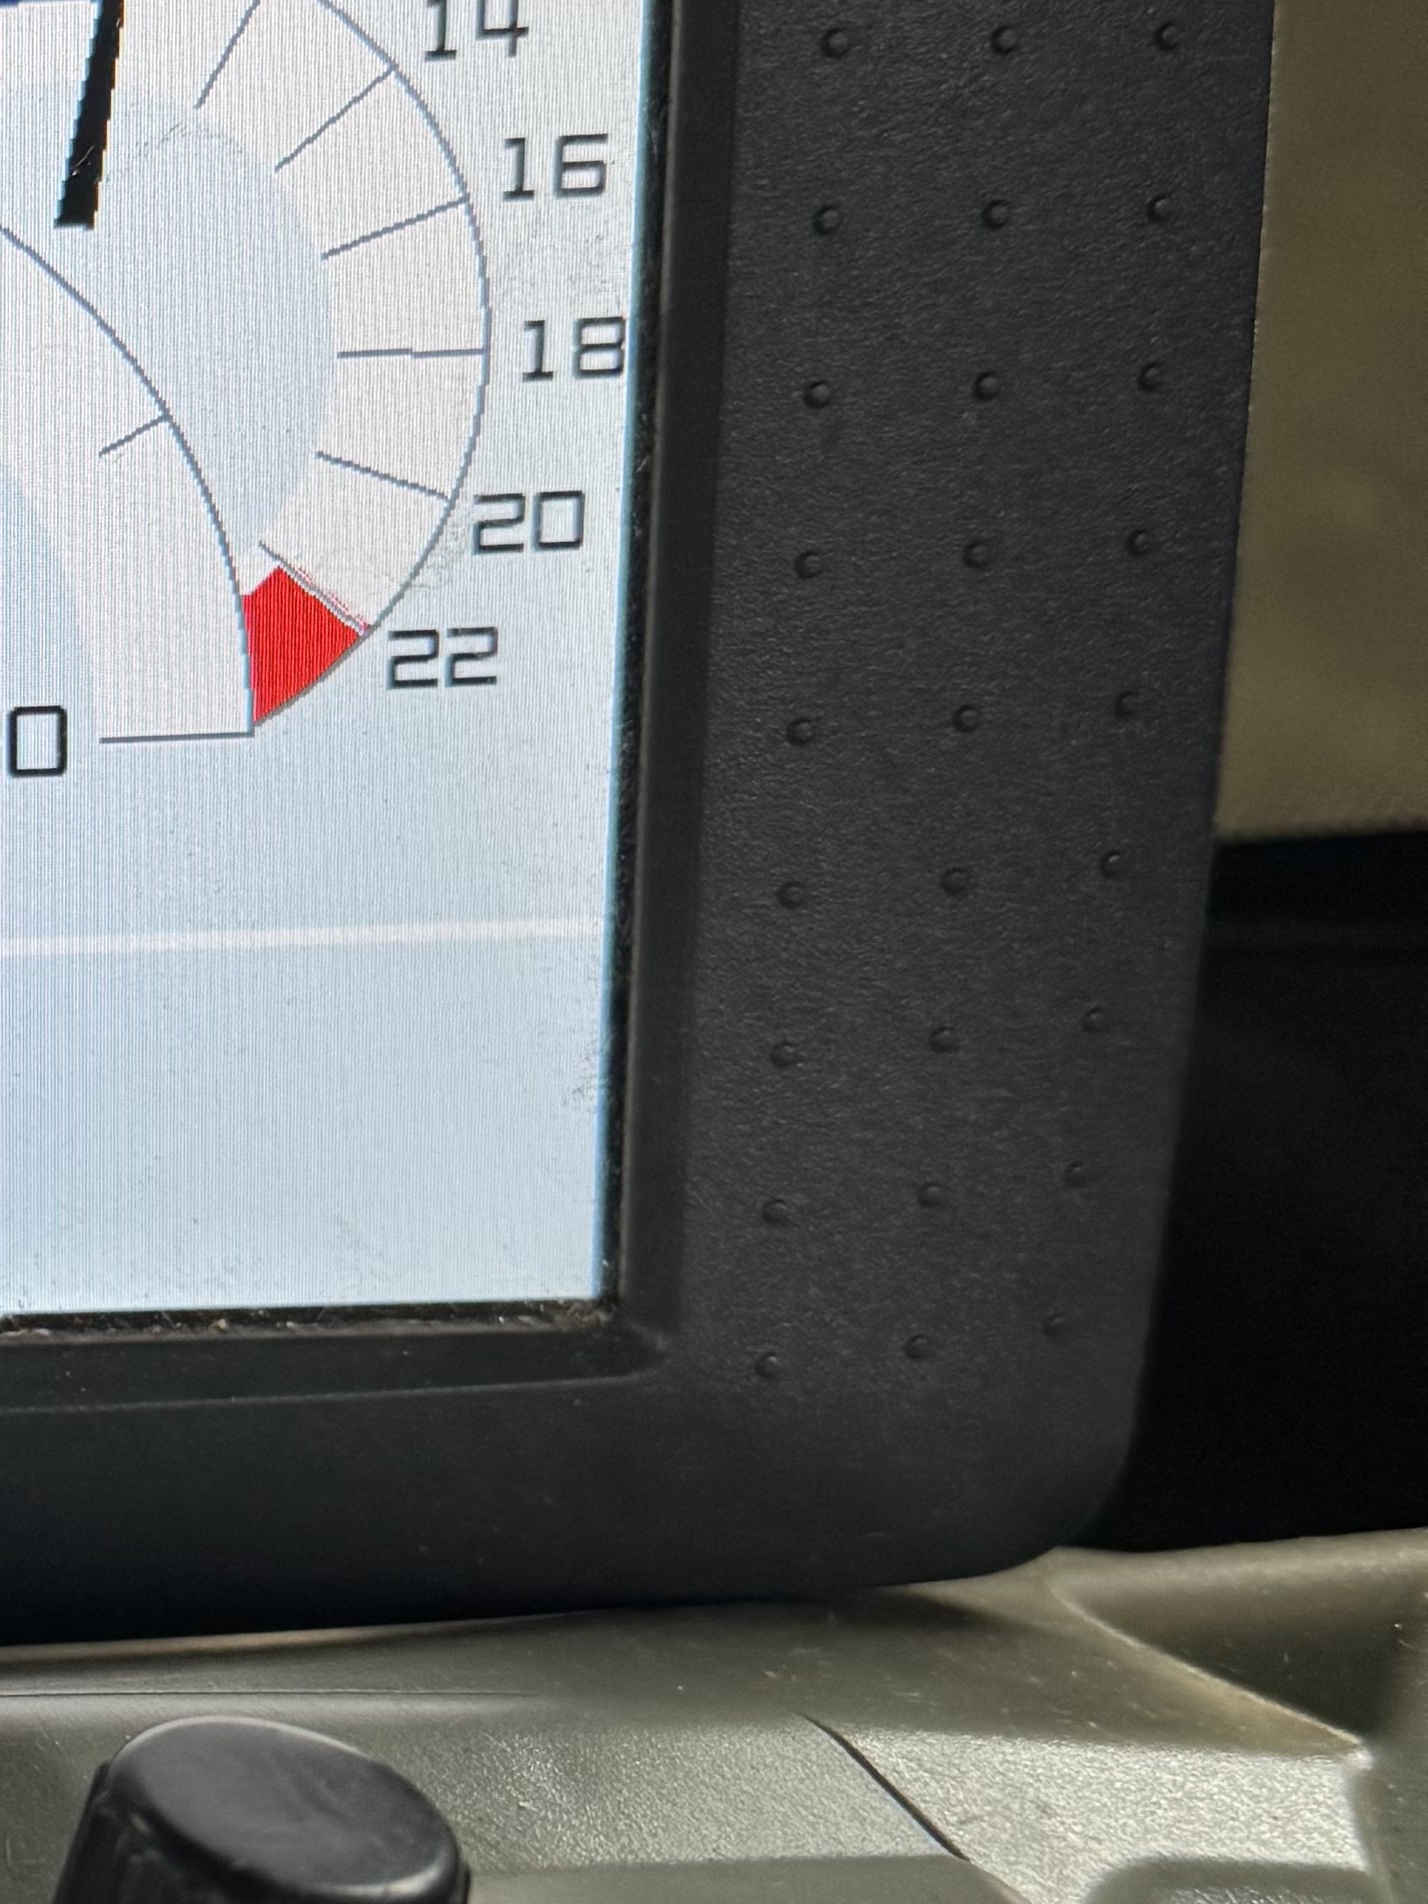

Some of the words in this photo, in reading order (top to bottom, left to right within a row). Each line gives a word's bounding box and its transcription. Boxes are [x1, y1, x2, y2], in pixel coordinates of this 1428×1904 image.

[503, 133, 608, 201] 16
[522, 315, 626, 383] 18
[473, 490, 585, 554] 20
[388, 626, 498, 689] 22
